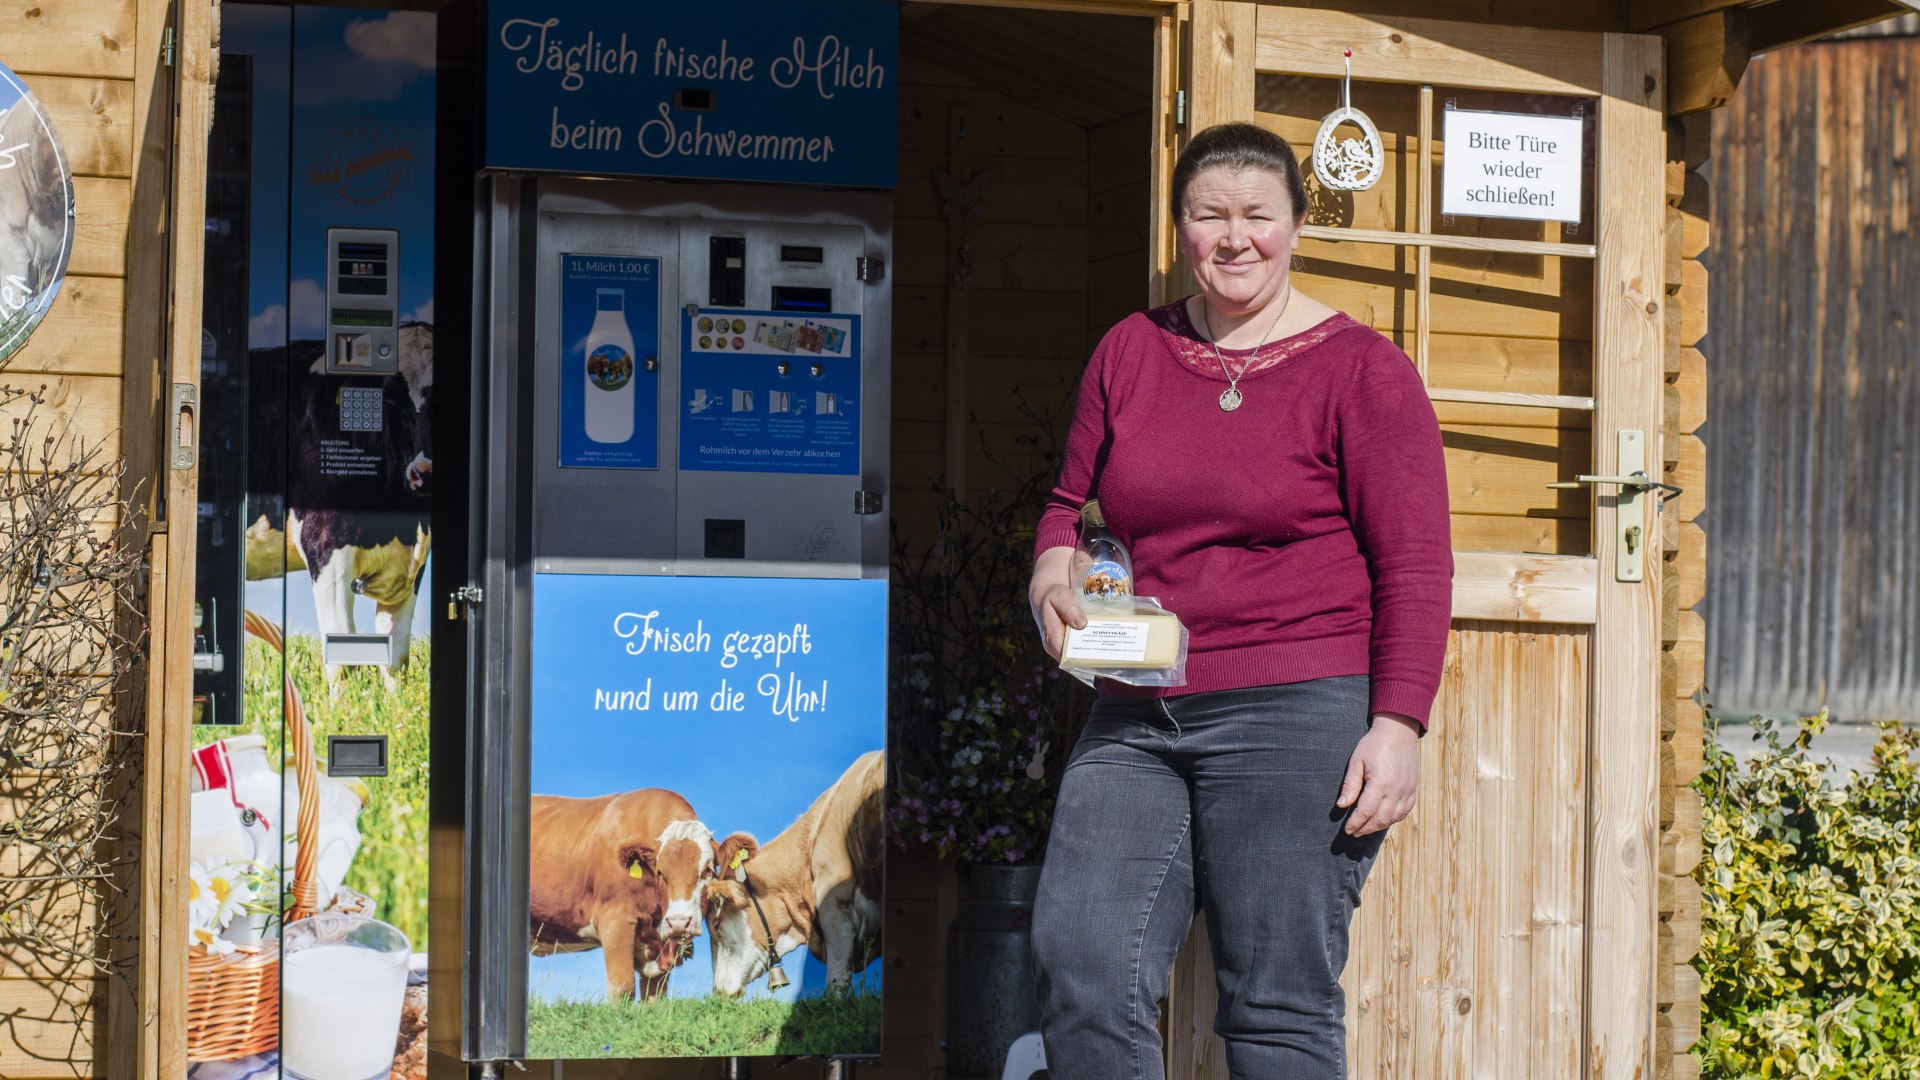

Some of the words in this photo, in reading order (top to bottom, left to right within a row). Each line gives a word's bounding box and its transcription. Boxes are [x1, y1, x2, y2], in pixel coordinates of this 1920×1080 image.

[501, 18, 638, 91] Täglich
[653, 37, 754, 82] frische
[769, 34, 885, 99] Milch
[550, 106, 622, 151] beim
[638, 101, 834, 162] Schwemmer
[1468, 131, 1511, 150] Bitte
[1516, 134, 1557, 154] Türe
[1482, 160, 1543, 179] wieder
[1466, 185, 1555, 207] schließen!
[571, 260, 584, 271] 1L
[586, 261, 616, 273] Milch
[618, 262, 642, 275] 1,00
[643, 263, 652, 274] €
[700, 445, 737, 455] Rohmilch
[752, 447, 770, 456] dem
[771, 448, 802, 457] Verzehr
[803, 448, 841, 458] abkochen
[614, 610, 711, 655] Frisch
[720, 623, 812, 668] gezapft
[594, 678, 651, 711] rund
[663, 691, 698, 711] um
[710, 679, 745, 712] die
[757, 672, 827, 722] Uhr!
